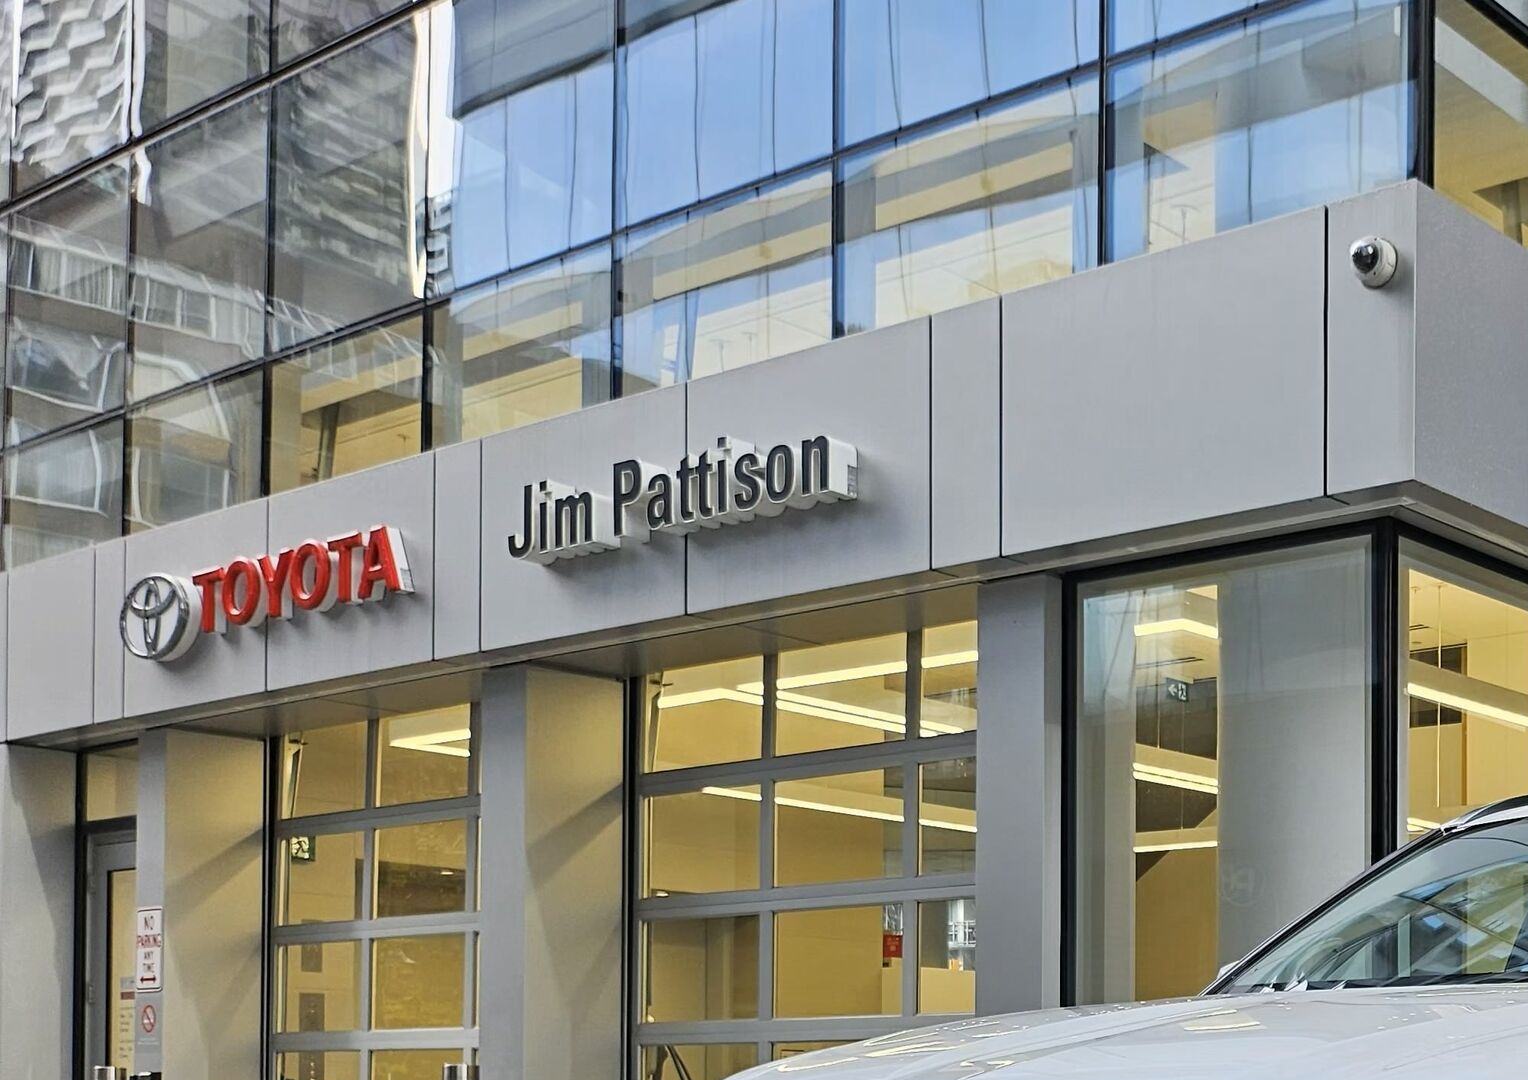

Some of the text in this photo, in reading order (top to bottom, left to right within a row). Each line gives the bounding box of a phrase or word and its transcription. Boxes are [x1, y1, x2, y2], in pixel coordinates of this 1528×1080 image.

[508, 434, 830, 559] Jim Pattison
[192, 525, 405, 635] TOYOTA
[136, 932, 161, 948] PARKING
[143, 915, 155, 930] NO
